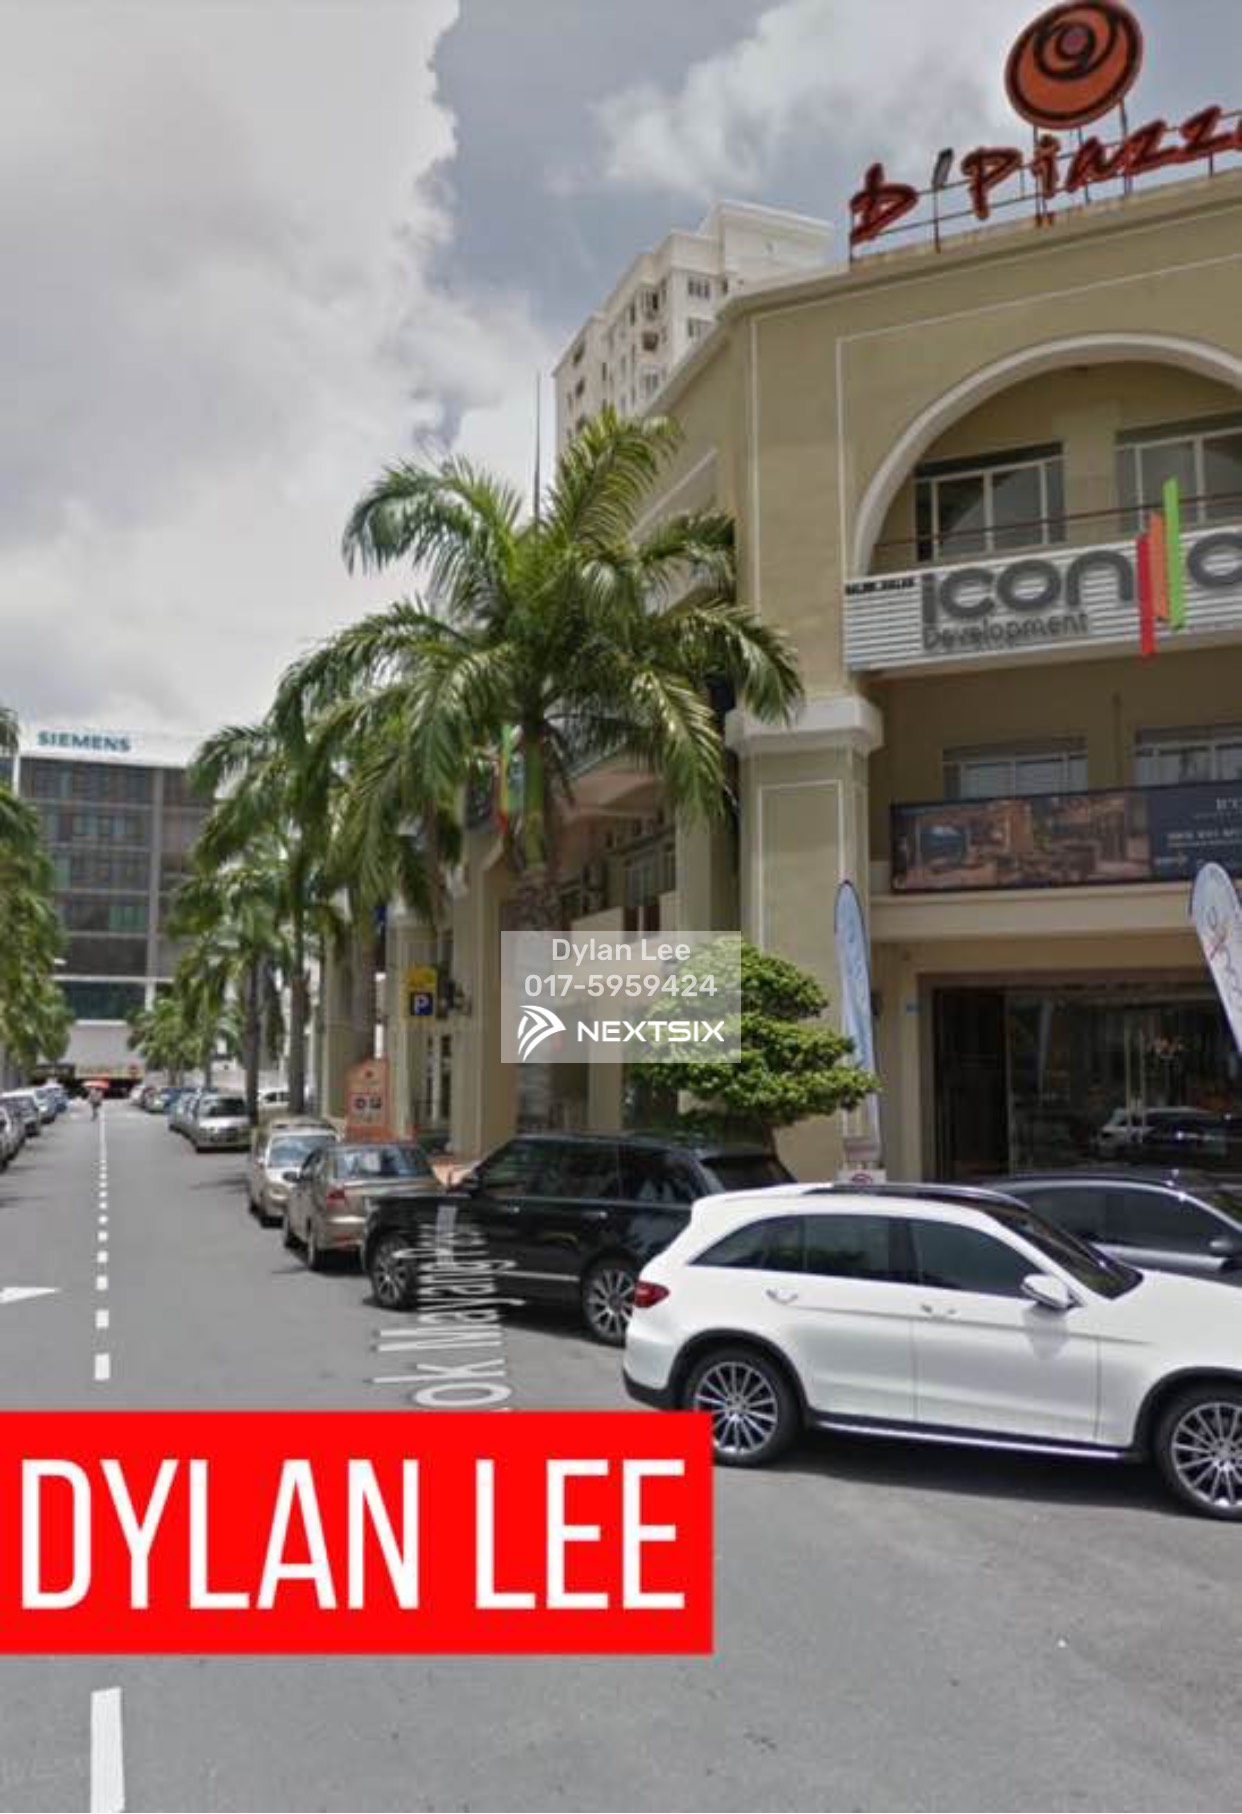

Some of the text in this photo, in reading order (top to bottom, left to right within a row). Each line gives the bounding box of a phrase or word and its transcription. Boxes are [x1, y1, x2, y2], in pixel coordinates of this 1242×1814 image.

[921, 550, 1136, 624] icon
[922, 612, 1089, 650] Development
[38, 731, 131, 751] SIEMENS
